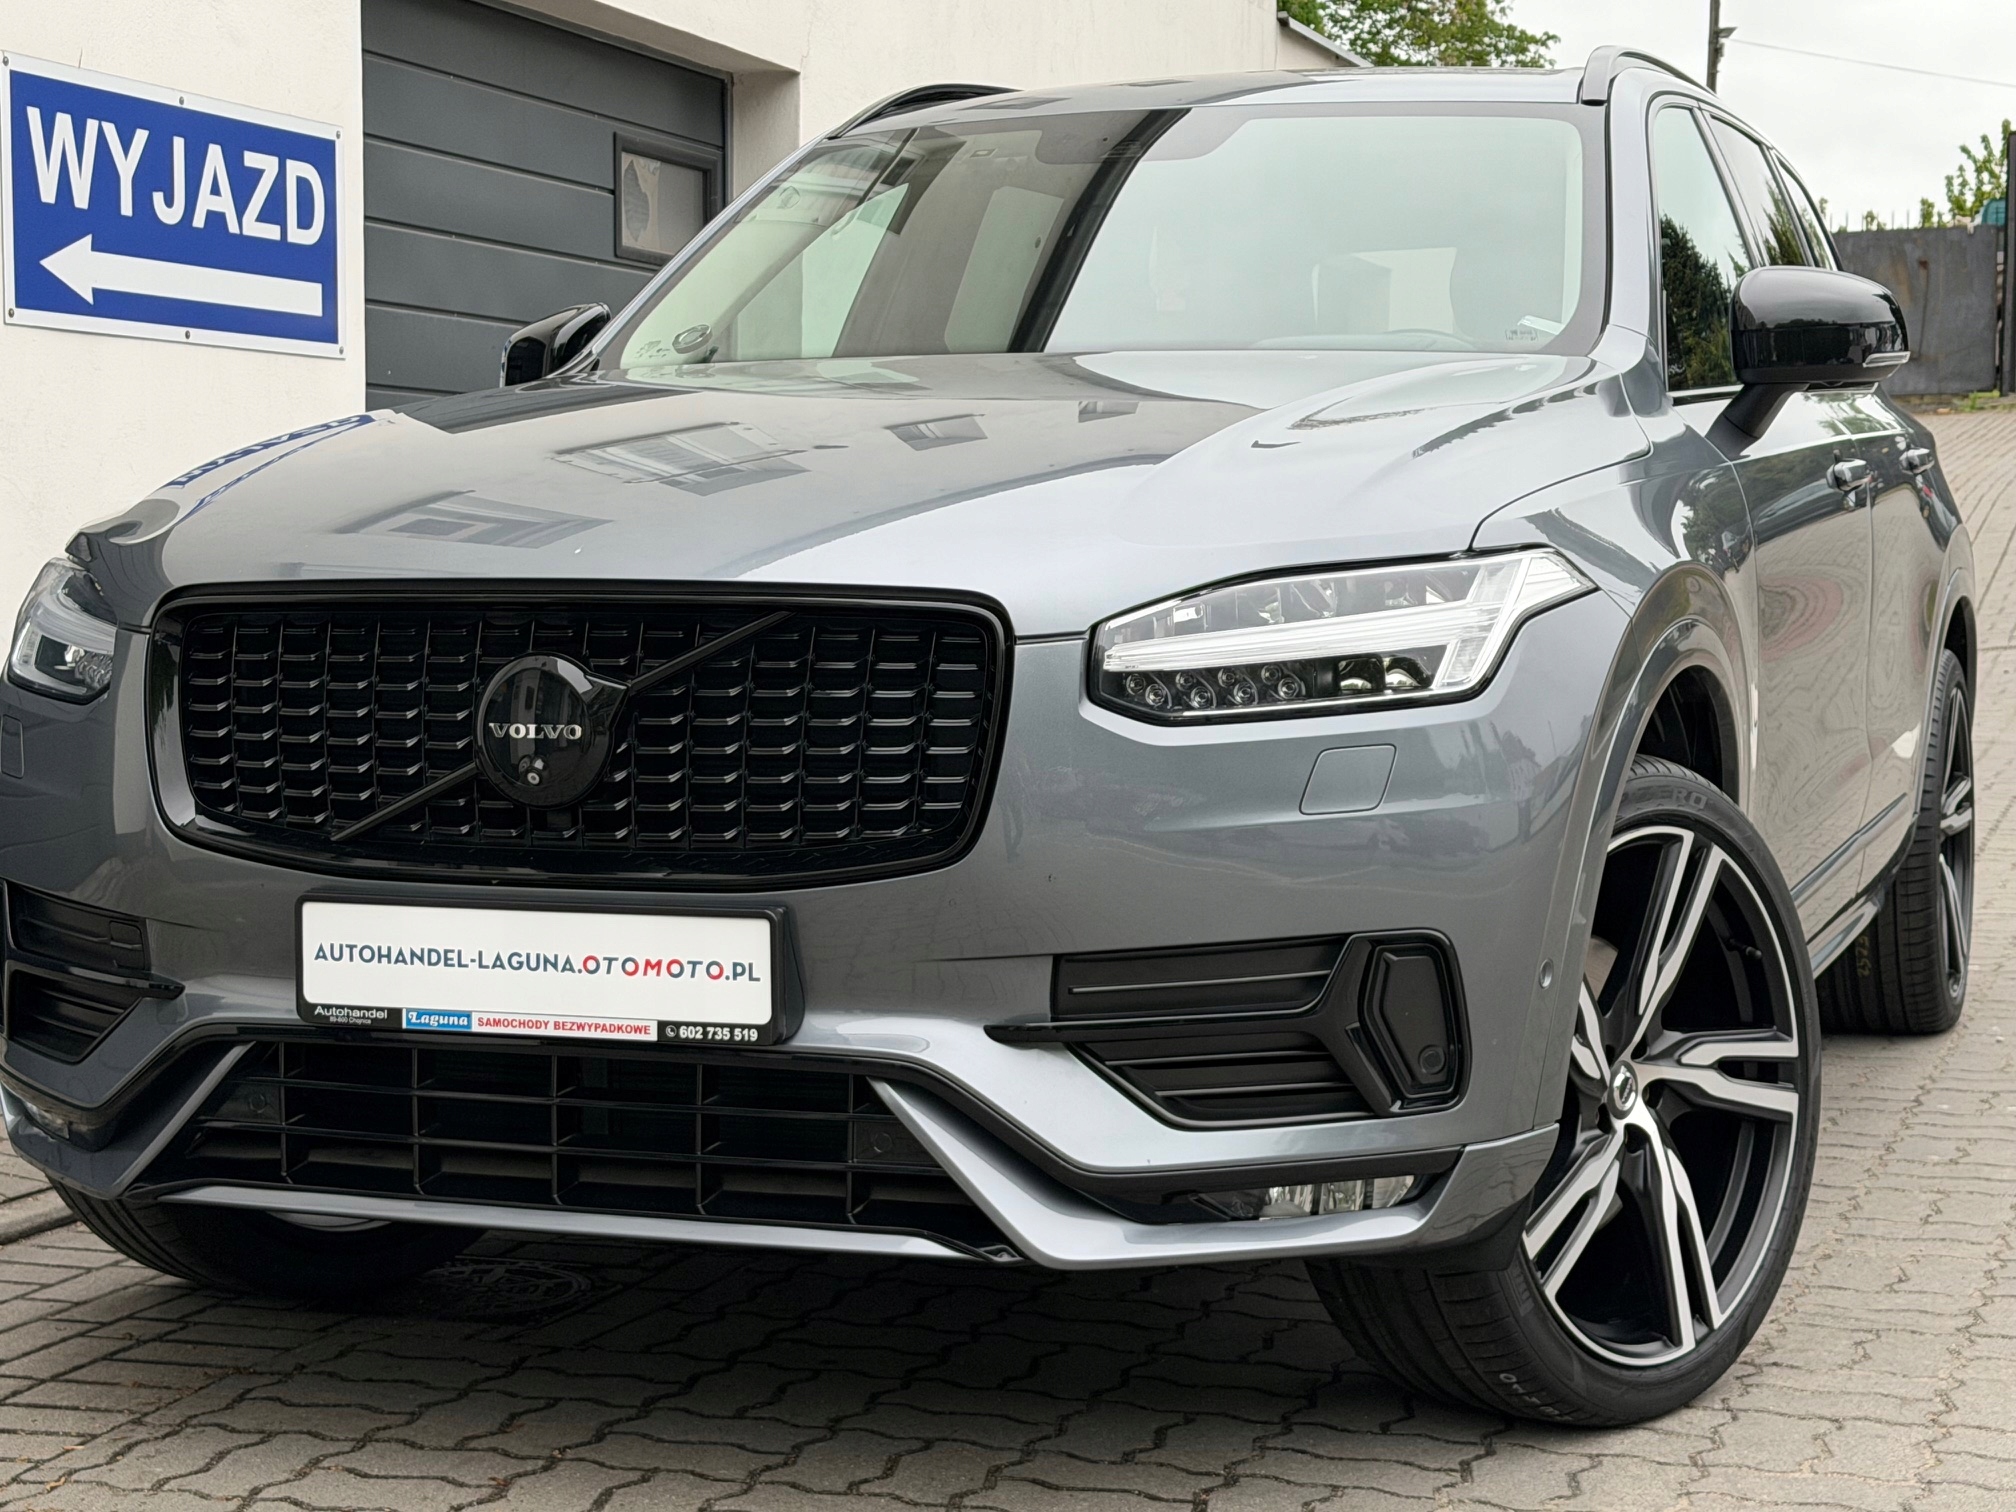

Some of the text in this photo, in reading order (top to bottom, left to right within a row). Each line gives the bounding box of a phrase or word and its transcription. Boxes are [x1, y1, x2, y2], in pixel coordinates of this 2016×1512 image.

[26, 106, 325, 246] WYJAZD
[488, 722, 583, 740] VOLVO
[314, 942, 761, 982] AUTOHANDEL-LAGUNA.OTOMOTO.PL
[314, 1005, 388, 1019] Autohandel
[408, 1011, 468, 1026] Laguna
[477, 1016, 651, 1035] SAMOCHODY BEZWYPADKOWE
[679, 1025, 758, 1042] 602 735 519
